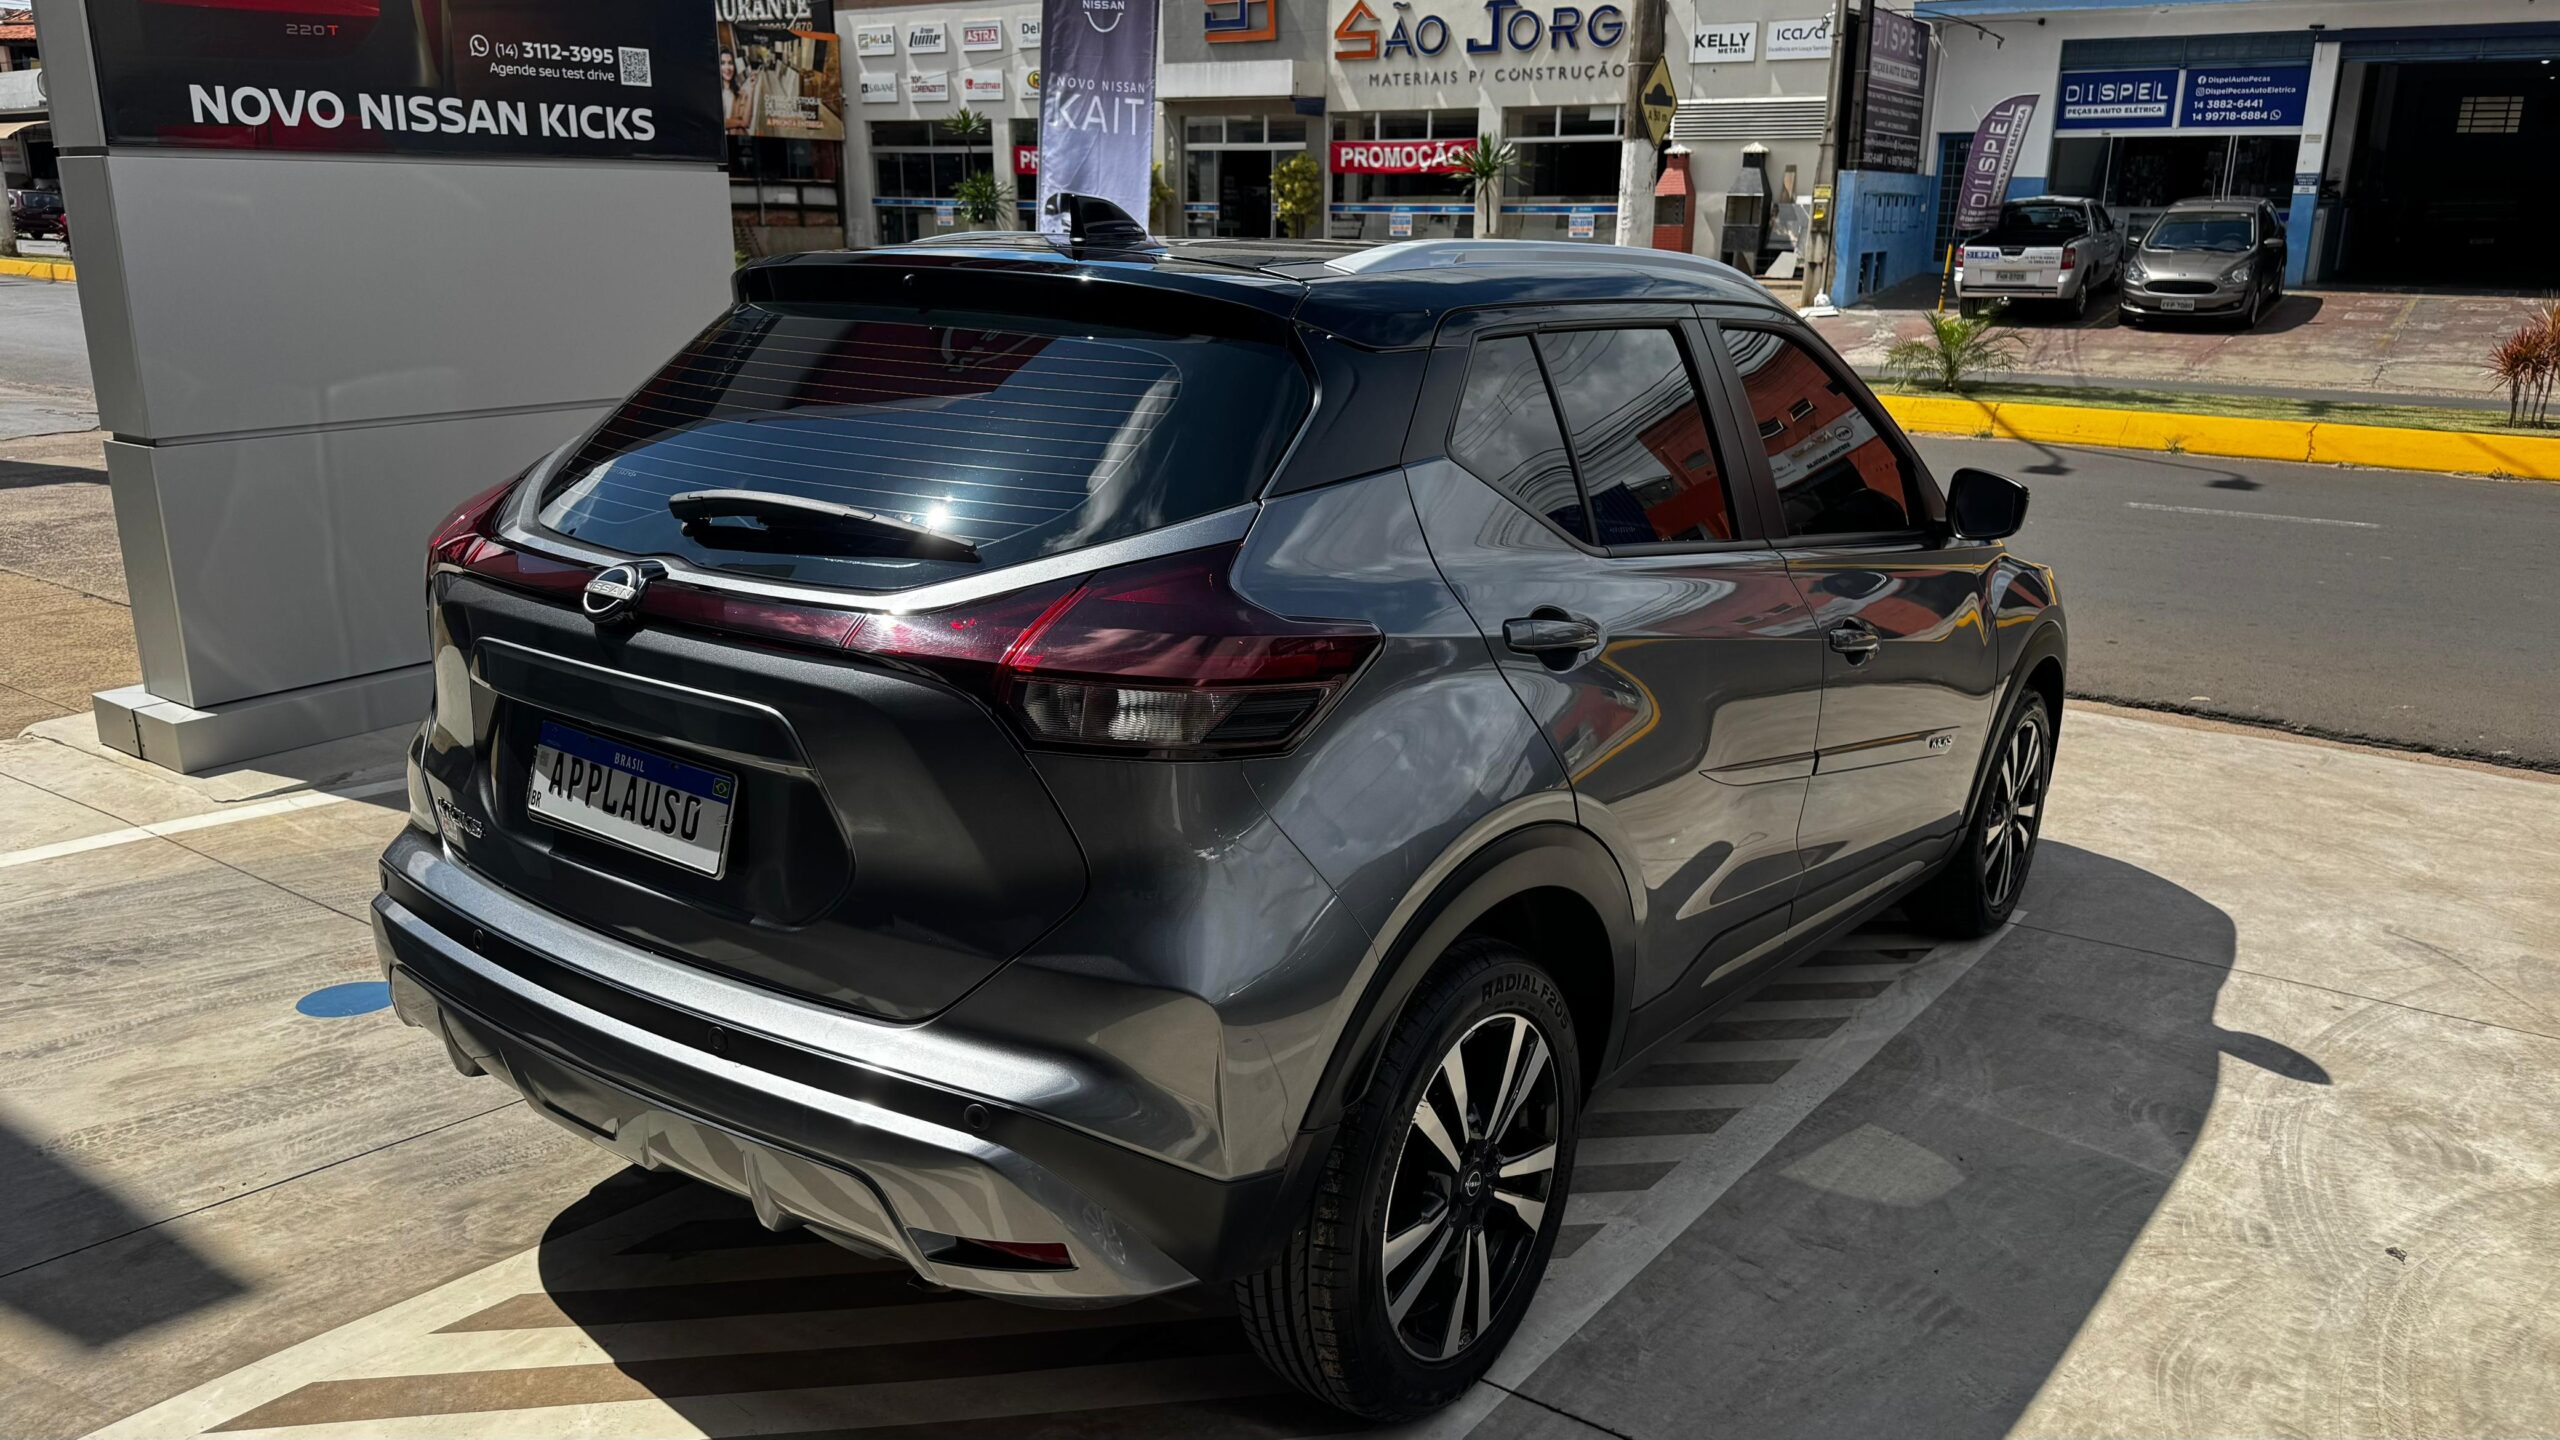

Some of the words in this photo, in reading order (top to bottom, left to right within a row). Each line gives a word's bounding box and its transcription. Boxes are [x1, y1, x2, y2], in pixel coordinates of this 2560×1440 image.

[714, 0, 812, 21] URANTE
[1083, 0, 1125, 10] NISSAN
[286, 24, 339, 36] 220T
[967, 29, 996, 42] ASTRA
[1335, 0, 1450, 60] SÃO
[1872, 17, 1923, 60] DISPEL
[1694, 32, 1750, 49] KELLY
[495, 42, 519, 60] (14)
[522, 41, 614, 64] 3112-3995
[490, 62, 537, 77] Agende
[538, 67, 560, 77] seu
[561, 67, 585, 81] test
[587, 69, 615, 82] drive
[1369, 70, 1458, 88] MATERIAIS
[1495, 60, 1625, 83] CONSTRUÇÃO
[2208, 76, 2271, 84] DispelAutoPecas
[1056, 77, 1095, 89] NOVO
[1102, 81, 1146, 94] NISSAN
[2065, 82, 2168, 102] DISPEL
[2205, 86, 2296, 95] DispelPecasAutoEletrica
[188, 83, 345, 128] NOVO
[359, 93, 528, 137] NISSAN
[540, 102, 656, 141] KICKS
[1052, 91, 1145, 136] KAIT
[2067, 107, 2092, 116] PEÇAS
[2124, 105, 2162, 113] ELÉTRICA
[2194, 101, 2204, 109] 14
[2207, 99, 2263, 109] 3882-6441
[2192, 113, 2203, 121] 14
[2205, 111, 2268, 121] 99718-6884
[1970, 103, 2015, 208] DISPEL
[586, 581, 634, 599] NISSAN
[614, 752, 645, 774] BRASIL
[531, 789, 542, 808] BR
[548, 752, 703, 843] APPLAUSO
[1481, 973, 1539, 1002] RADIAL
